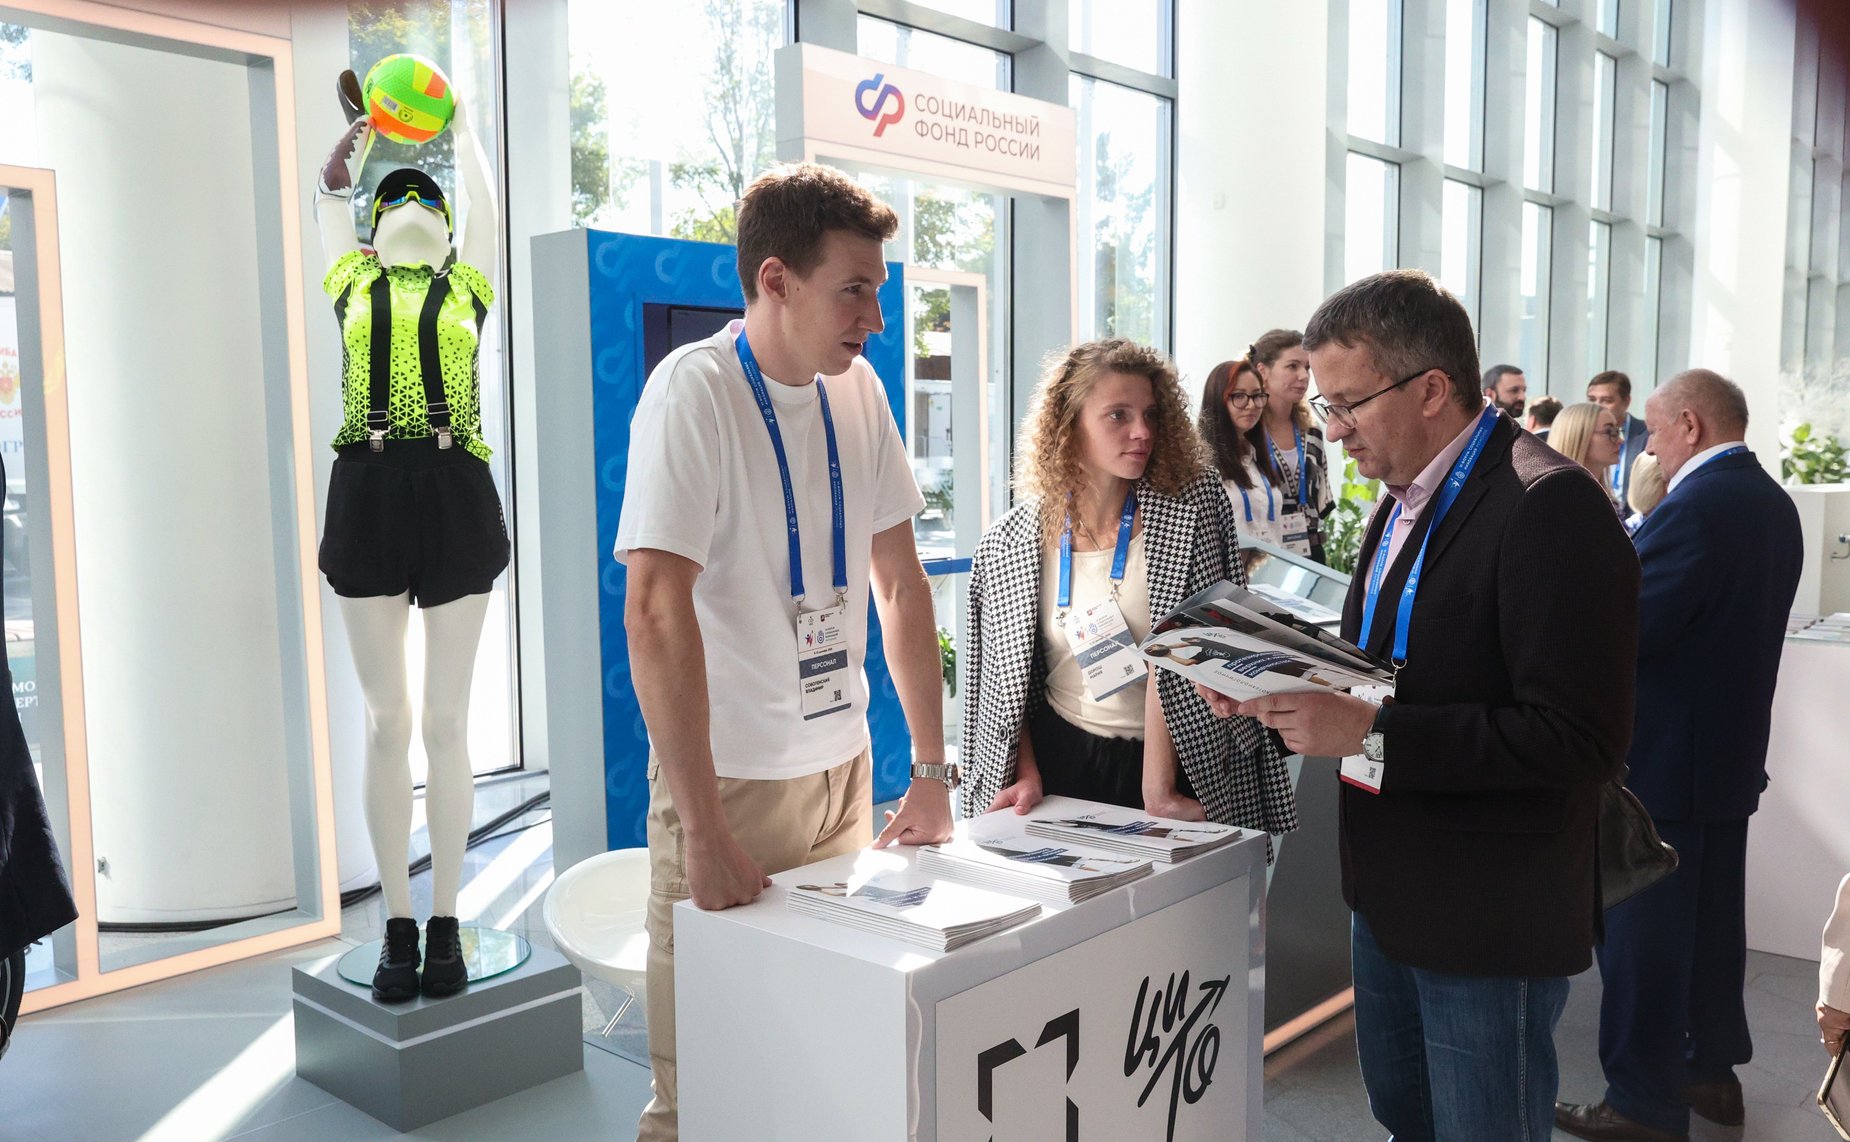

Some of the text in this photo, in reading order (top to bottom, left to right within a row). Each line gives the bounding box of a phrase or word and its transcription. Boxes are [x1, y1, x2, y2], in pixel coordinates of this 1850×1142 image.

[914, 93, 1040, 137] СОЦИАЛЬНЫЙ
[914, 120, 1040, 161] ФОНД РОССИИ
[811, 658, 837, 670] ПЕРСОНАЛ
